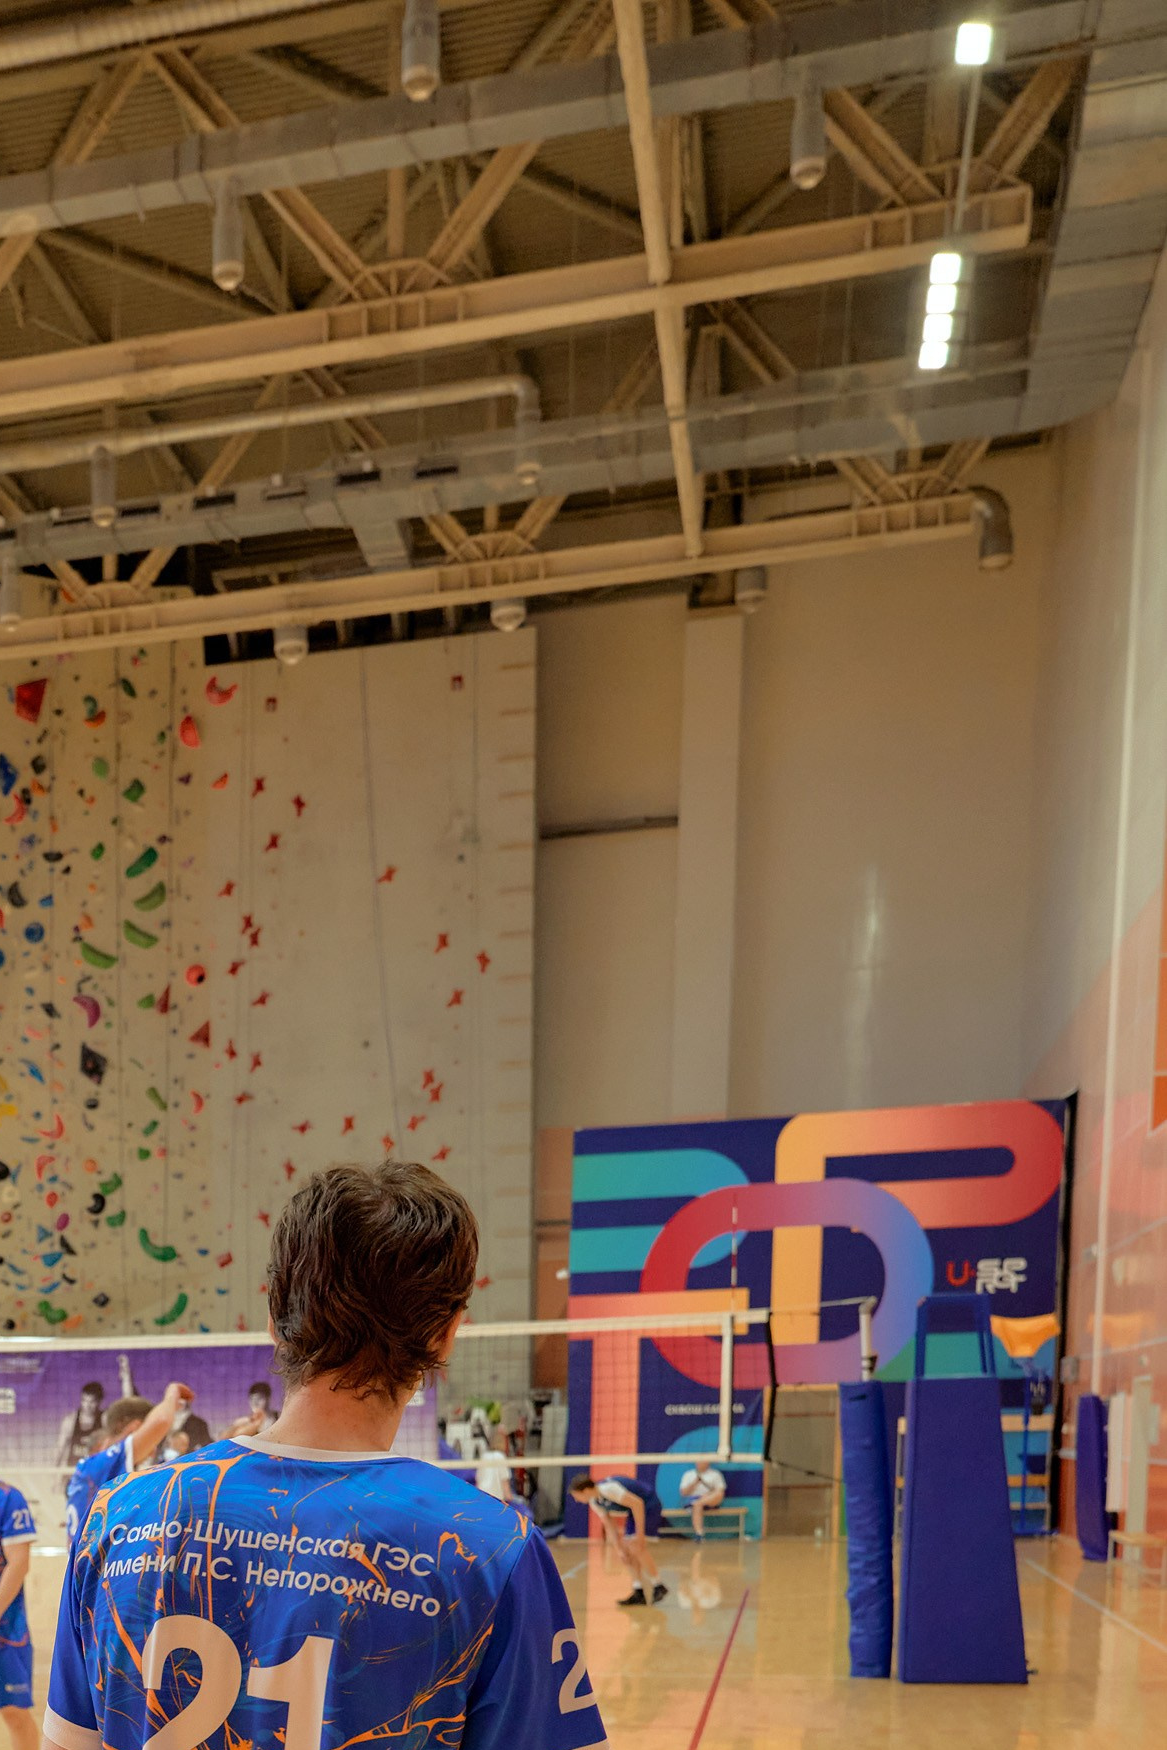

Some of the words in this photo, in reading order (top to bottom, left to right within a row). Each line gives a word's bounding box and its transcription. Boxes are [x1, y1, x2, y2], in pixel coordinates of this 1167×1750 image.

[109, 1519, 366, 1561] Саяно-Шушенская
[371, 1541, 435, 1577] ГЭС
[103, 1550, 177, 1579] имени
[183, 1552, 238, 1582] П.С.
[245, 1560, 441, 1617] Непорожнего
